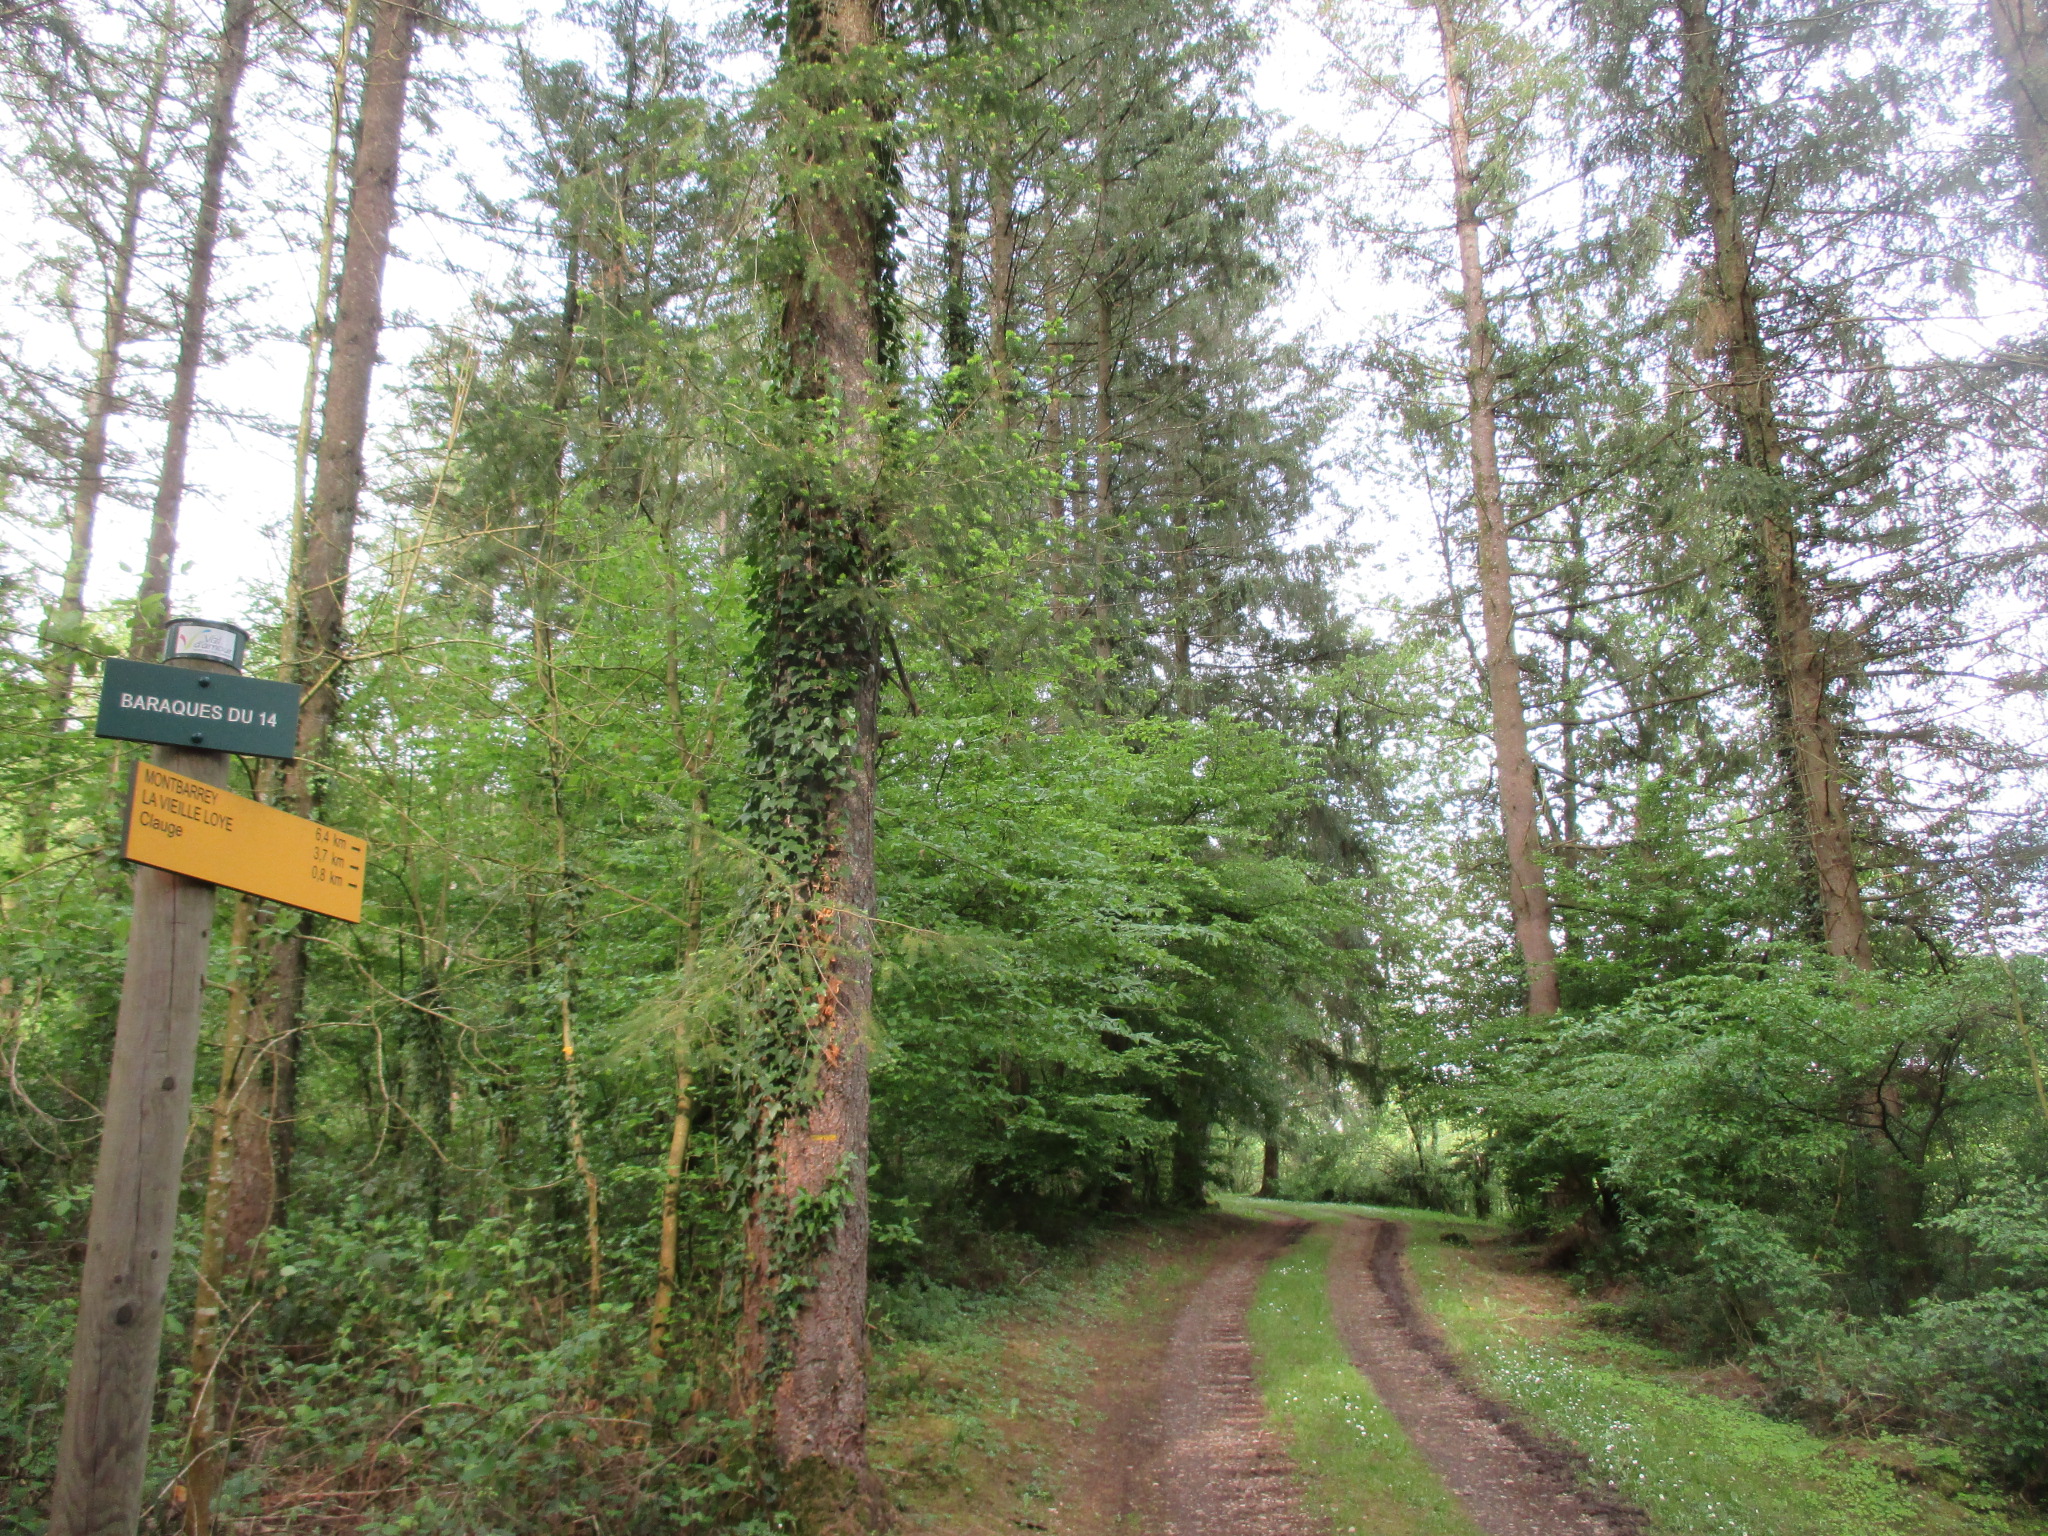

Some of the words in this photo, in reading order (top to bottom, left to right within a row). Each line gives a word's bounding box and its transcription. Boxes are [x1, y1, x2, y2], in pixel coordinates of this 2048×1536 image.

[120, 693, 223, 720] BARAQUES
[227, 707, 253, 724] DU
[259, 712, 278, 727] 14
[142, 789, 157, 807] LA
[160, 794, 202, 822] VIEILLE
[204, 809, 234, 832] LOYE
[313, 846, 328, 862] 3,7
[331, 851, 344, 868] km
[145, 768, 218, 805] MONTBARREY
[315, 827, 329, 843] 6,4
[333, 833, 346, 849] km
[139, 811, 183, 838] Clauge
[311, 865, 326, 882] 0,8
[330, 870, 343, 887] km
